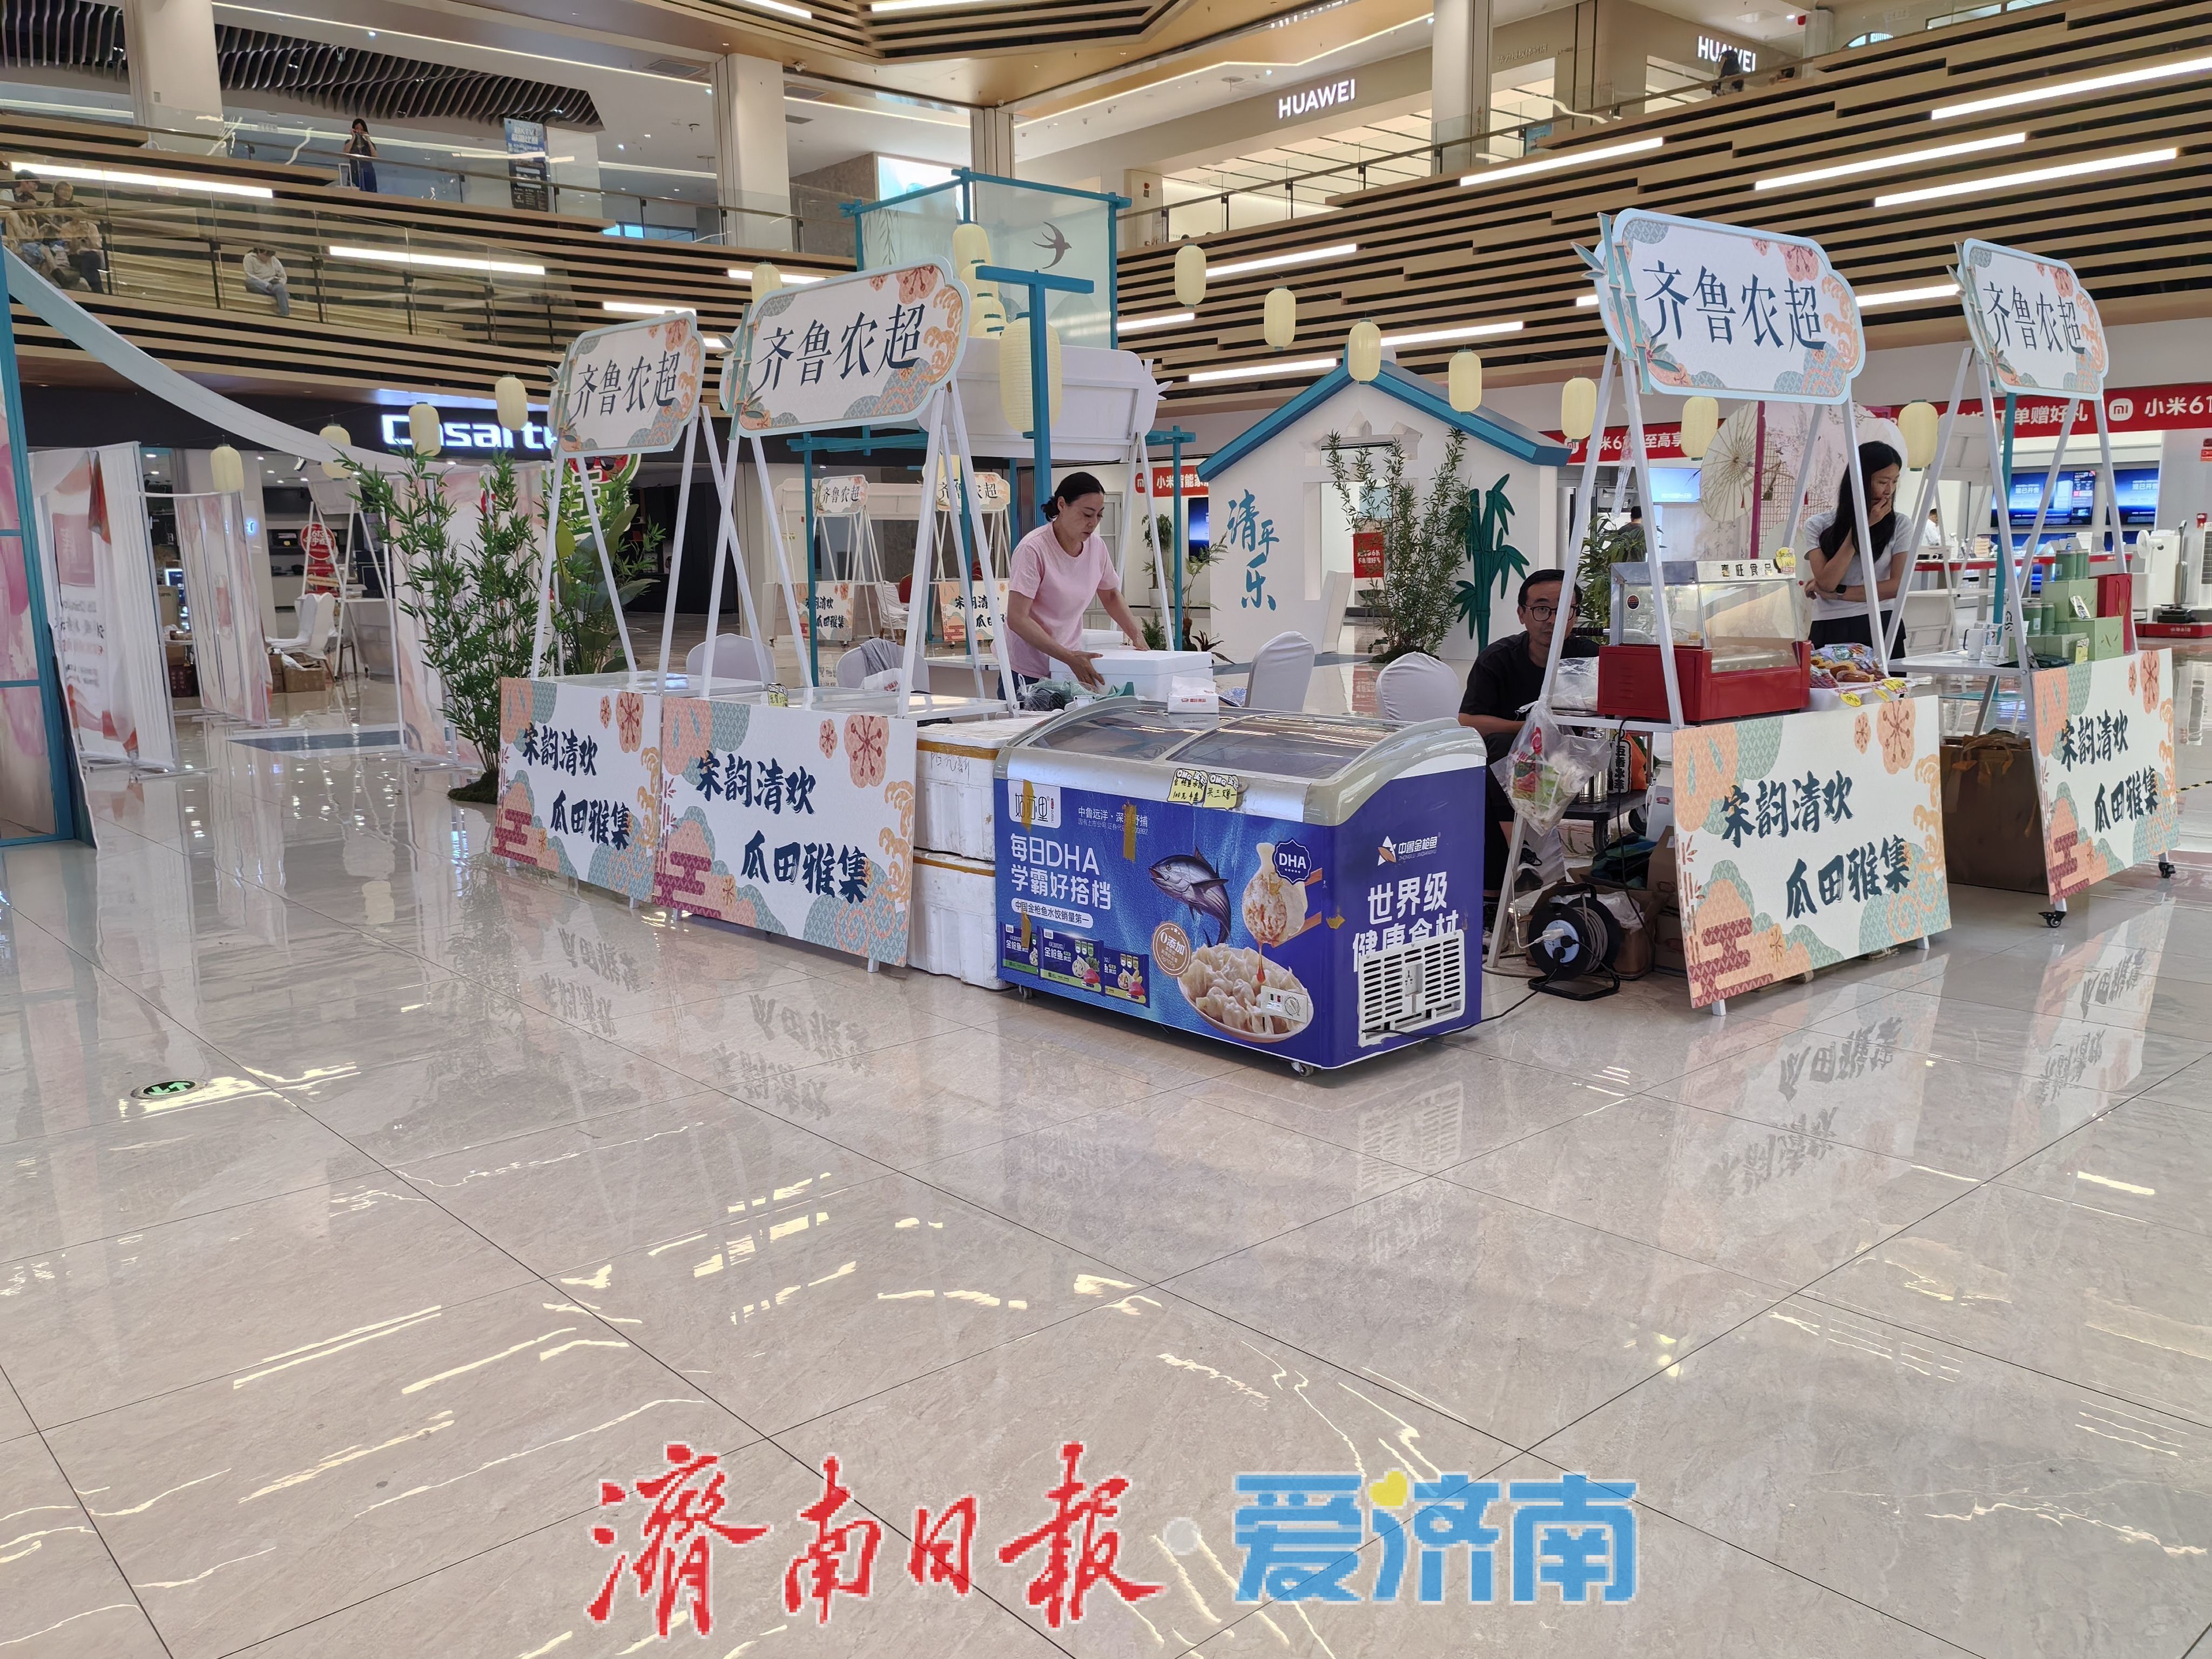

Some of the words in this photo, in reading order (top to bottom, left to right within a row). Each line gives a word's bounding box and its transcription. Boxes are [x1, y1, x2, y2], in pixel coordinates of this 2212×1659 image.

[1279, 79, 1355, 119] HUAWEI
[1642, 259, 1827, 352] 齐鲁农超
[1983, 280, 2085, 356] 齐鲁农超
[751, 303, 926, 398] 齐鲁农超
[568, 350, 680, 425] 齐鲁农超
[821, 485, 860, 504] 齐鲁农超
[1227, 489, 1279, 611] 清平乐
[1721, 563, 1773, 577] 喜旺食品
[522, 722, 598, 777] 宋韵清欢
[2060, 709, 2129, 772] 宋韵清欢
[696, 750, 817, 815] 宋韵清欢
[1721, 770, 1853, 848] 宋韵清欢
[2095, 765, 2160, 833] 瓜田雅集
[550, 789, 631, 851] 瓜田雅集
[740, 830, 869, 903] 瓜田雅集
[1010, 833, 1100, 875] 每日DHA
[1279, 853, 1306, 869] DHA
[1786, 834, 1911, 920] 瓜田雅集
[1011, 864, 1111, 910] 学霸好搭档
[1015, 900, 1090, 924] 中国金枪鱼水饺销量第一
[1367, 872, 1447, 925] 世界级
